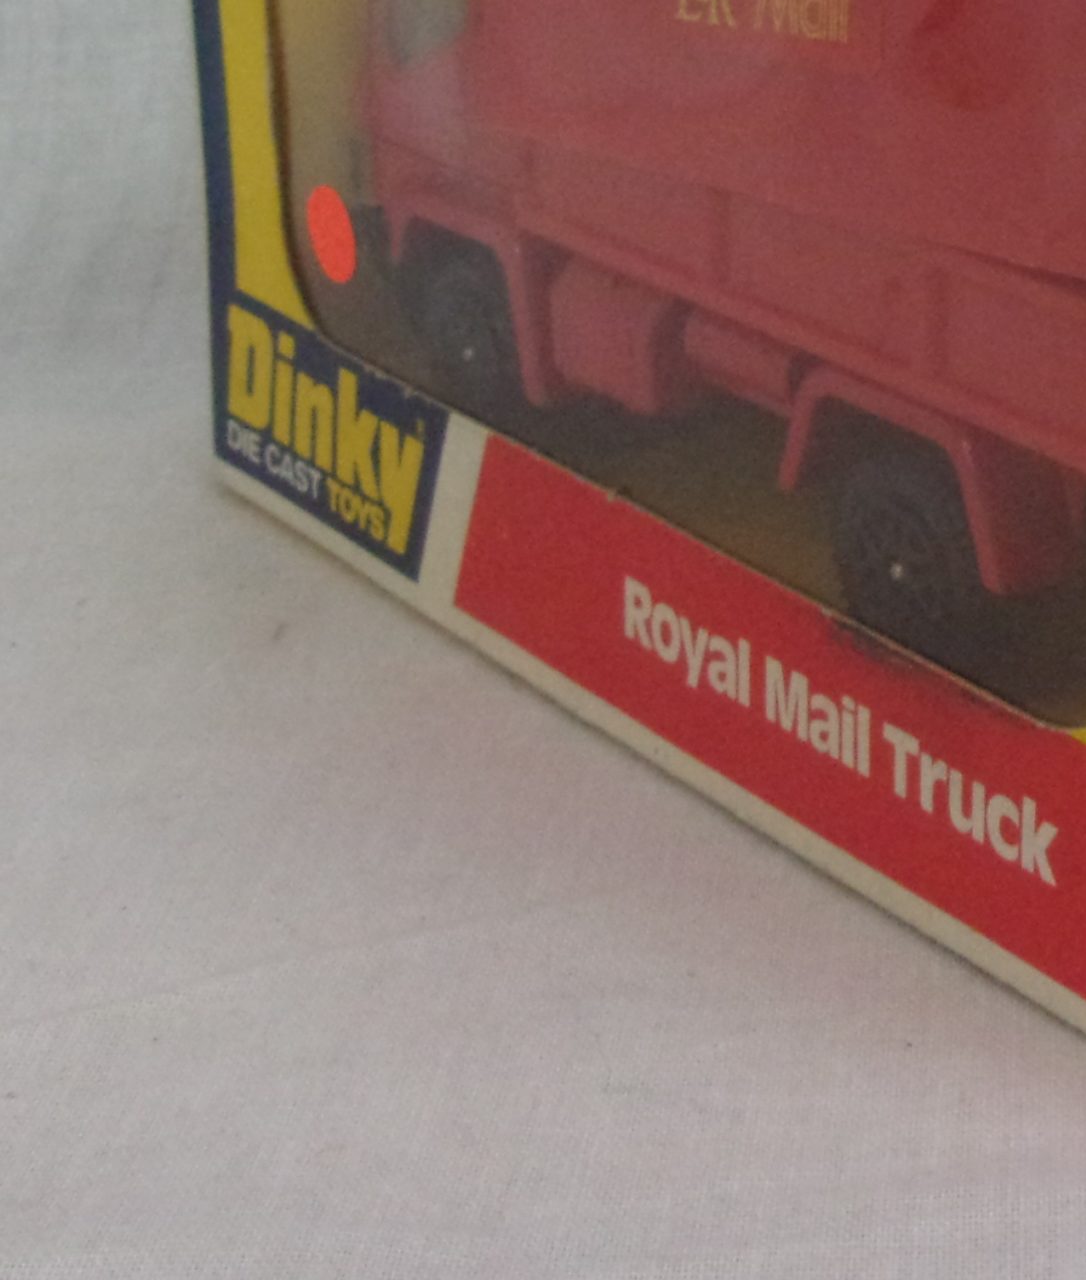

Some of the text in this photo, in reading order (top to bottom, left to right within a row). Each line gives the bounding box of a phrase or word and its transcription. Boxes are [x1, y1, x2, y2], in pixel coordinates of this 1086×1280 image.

[226, 418, 386, 543] DIE CAST TOYS
[227, 304, 424, 554] Dinky
[623, 575, 1060, 888] Royal Mail Truck
